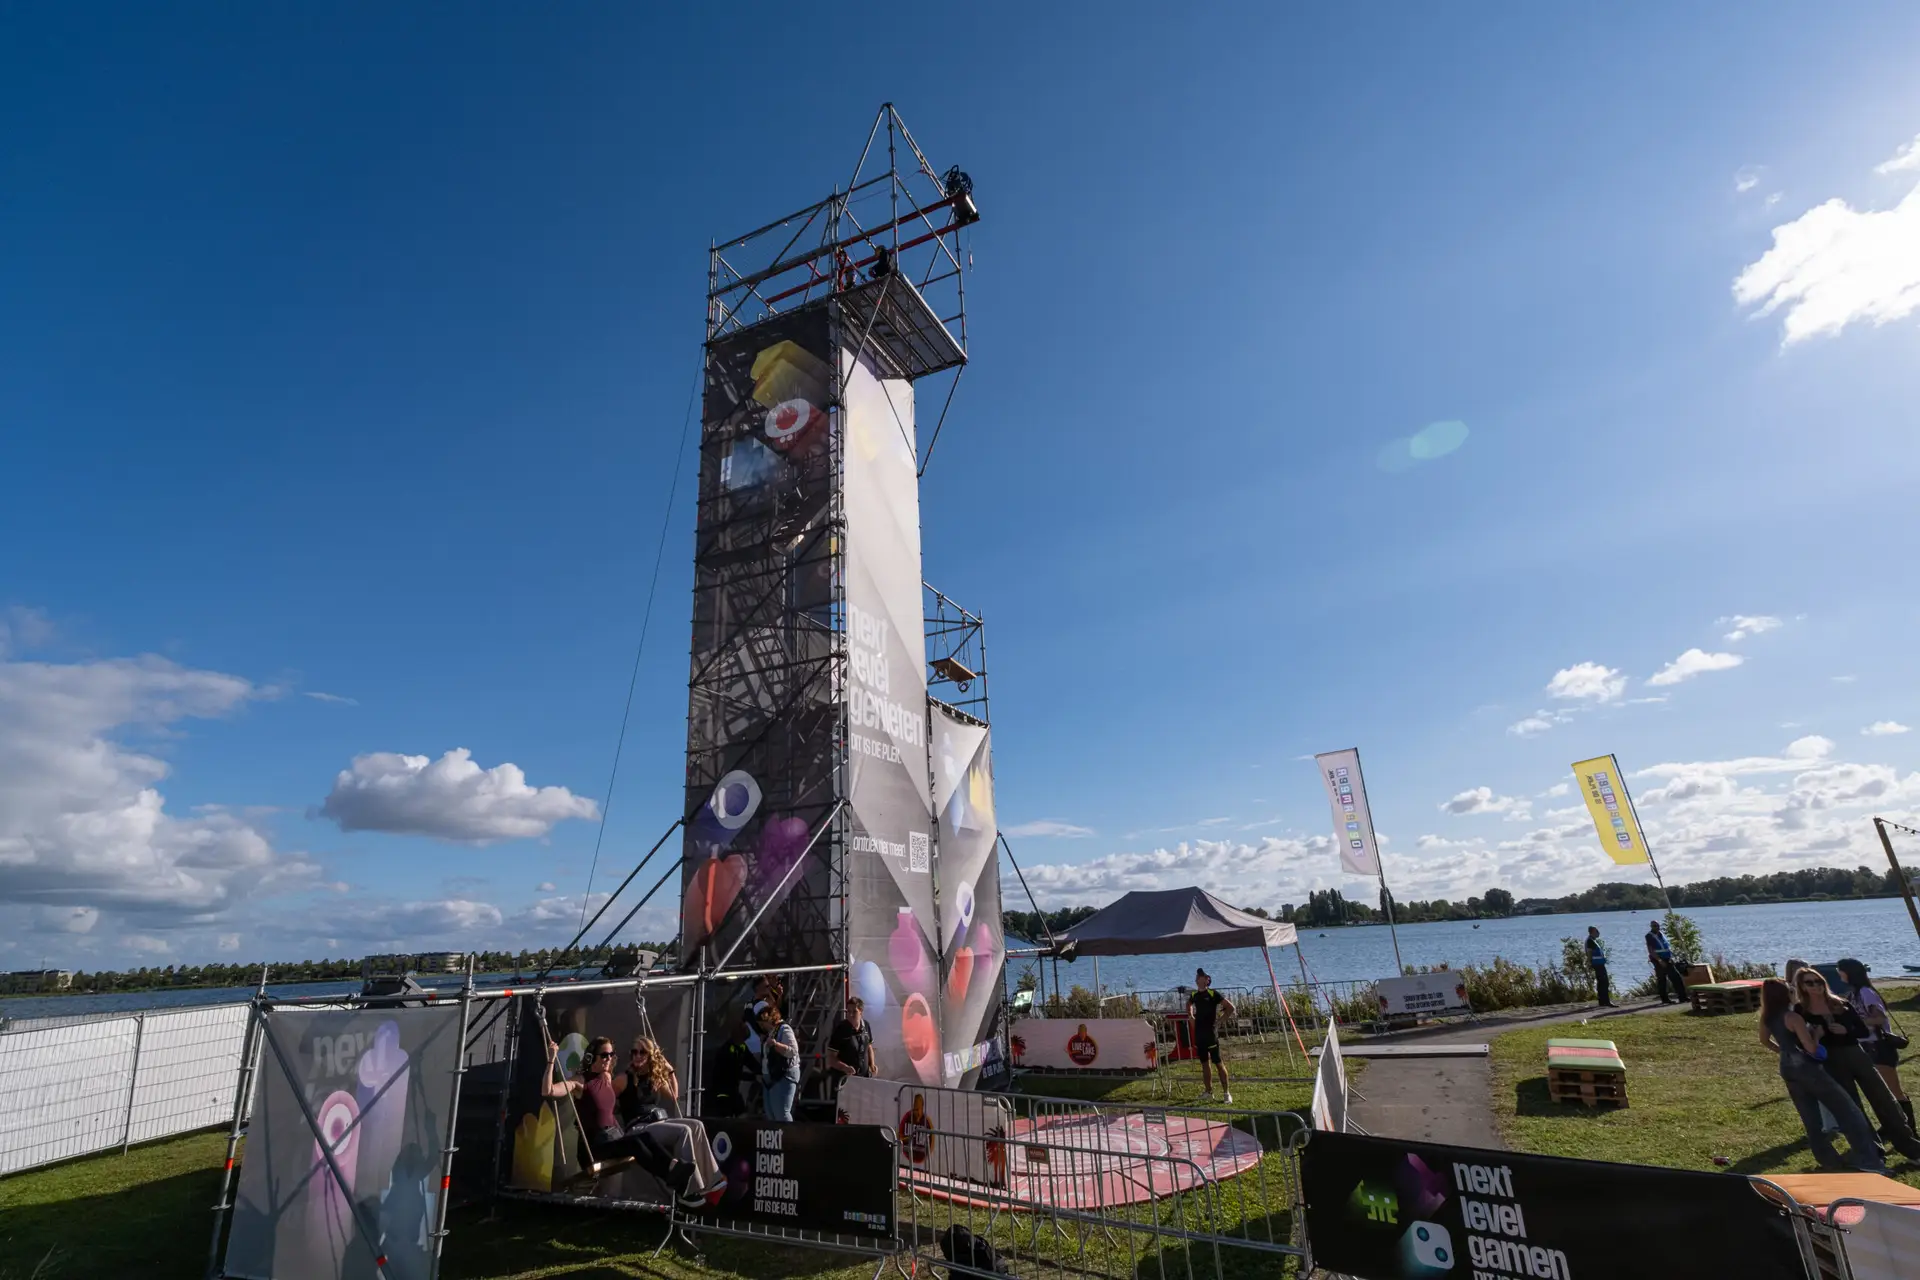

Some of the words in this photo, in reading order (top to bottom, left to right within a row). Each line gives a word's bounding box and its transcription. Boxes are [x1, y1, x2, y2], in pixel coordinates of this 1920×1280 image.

[848, 601, 889, 655] next
[849, 643, 891, 693] level
[850, 685, 925, 748] genieten
[851, 732, 862, 752] DIT
[863, 735, 871, 755] IS
[872, 740, 882, 758] DE
[1072, 1042, 1083, 1051] LIVE
[756, 1128, 783, 1150] next
[756, 1151, 784, 1175] level
[755, 1176, 799, 1201] gamen
[1452, 1162, 1515, 1198] next
[754, 1199, 764, 1212] DIT
[764, 1200, 772, 1213] IS
[771, 1201, 780, 1214] DE
[1460, 1196, 1528, 1239] level
[1467, 1234, 1571, 1280] gamen
